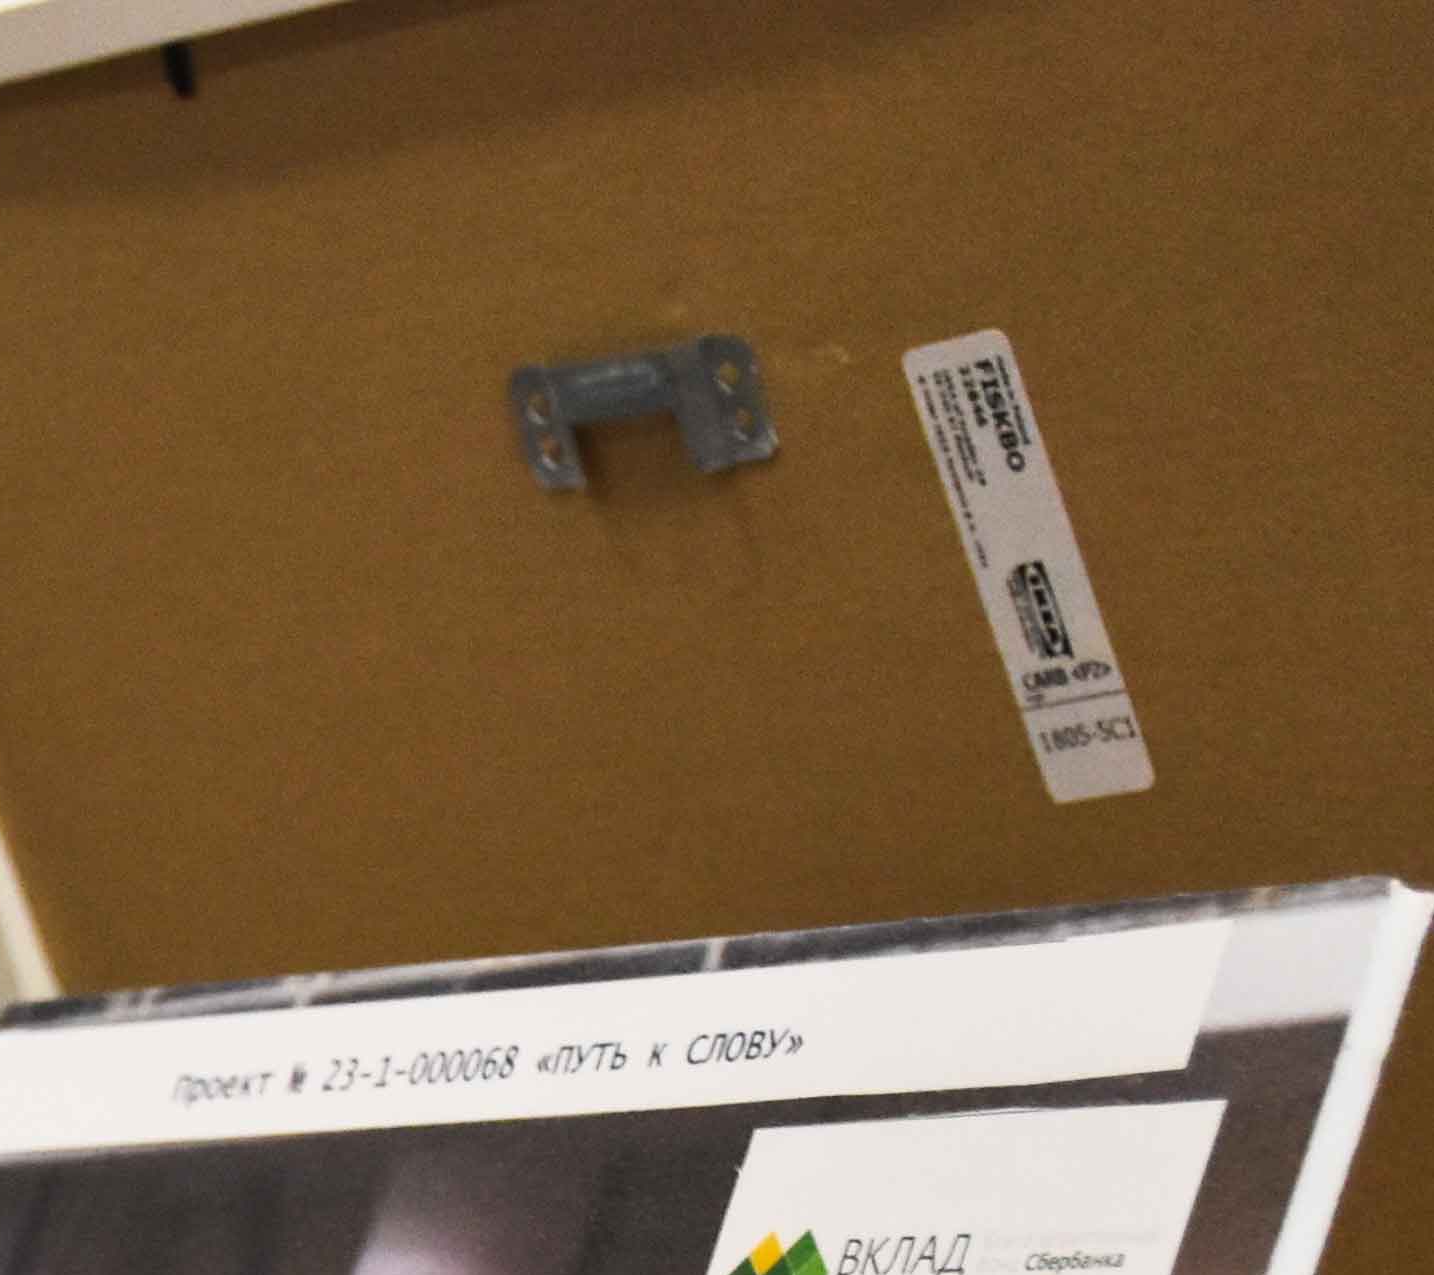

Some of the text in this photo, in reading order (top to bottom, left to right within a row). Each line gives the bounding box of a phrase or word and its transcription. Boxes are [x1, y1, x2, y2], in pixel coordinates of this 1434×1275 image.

[973, 358, 1026, 473] FISKBO
[321, 1045, 520, 1093] 23-1-000068
[536, 1041, 629, 1075] «ПУТЬ
[685, 1027, 804, 1065] СЛОВУ»
[1025, 1249, 1127, 1275] Сбербанка
